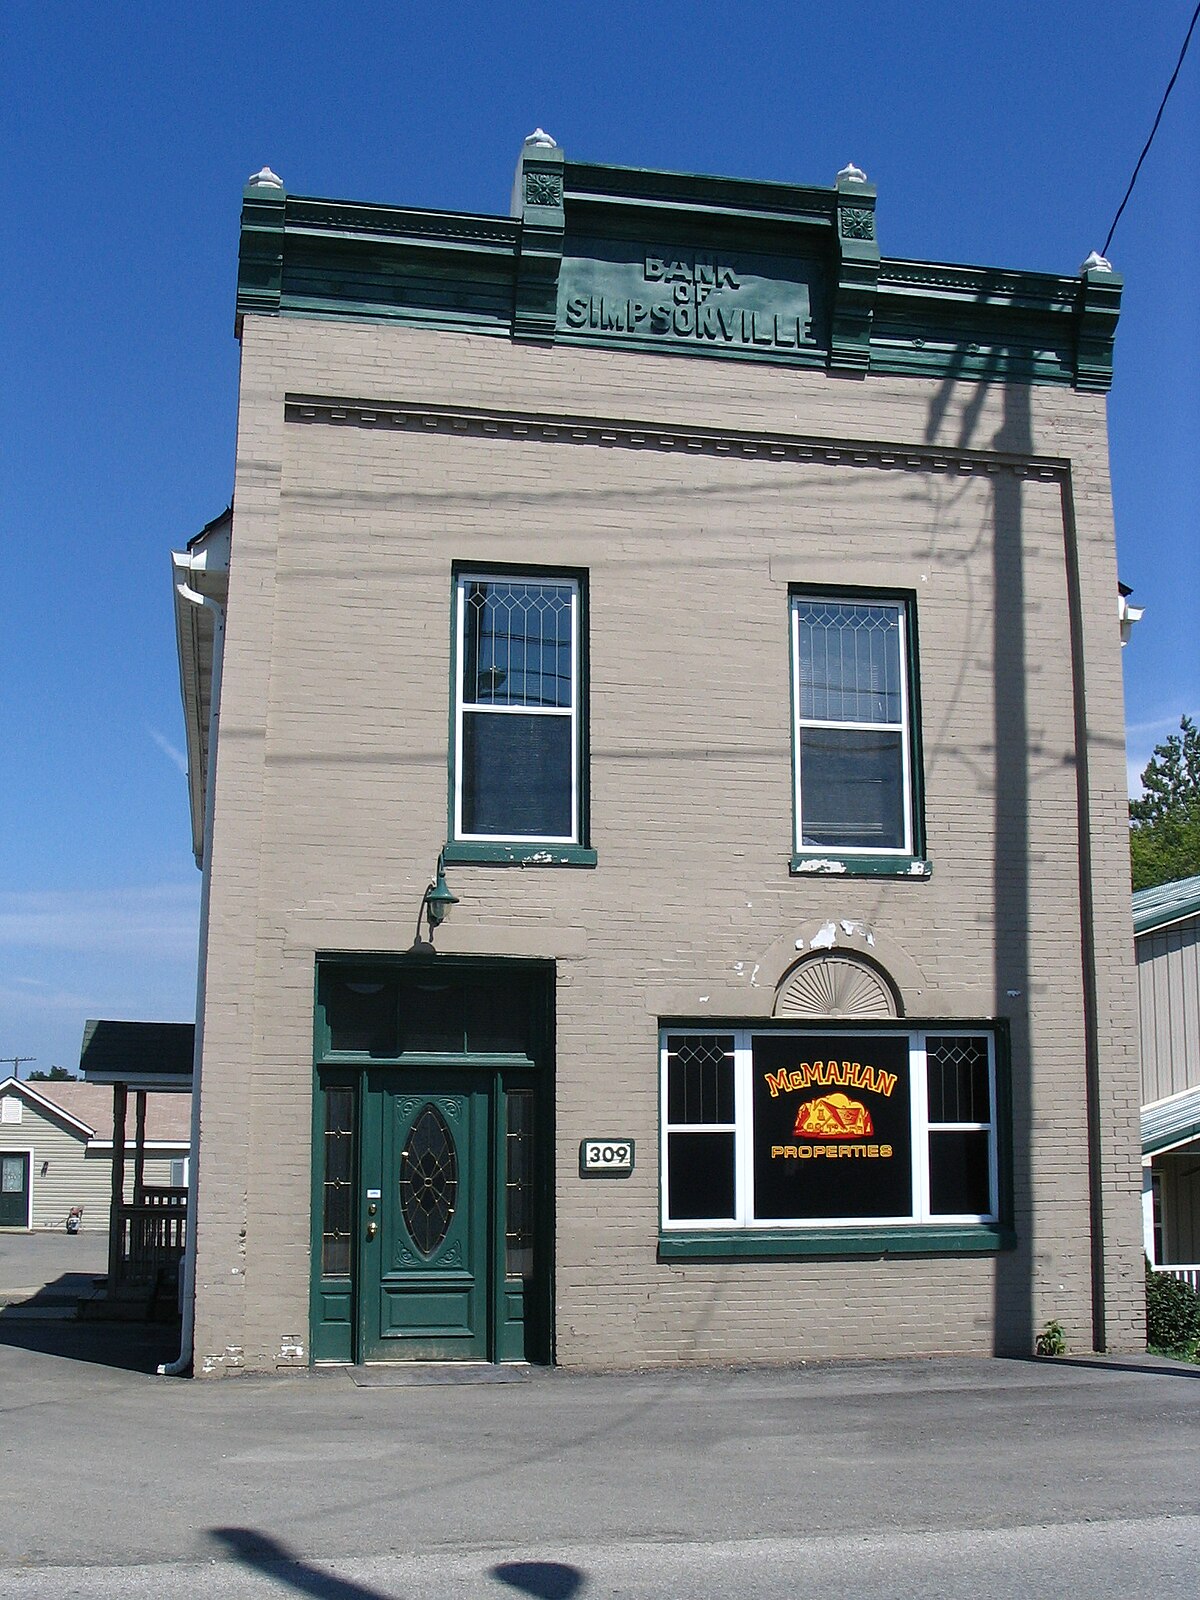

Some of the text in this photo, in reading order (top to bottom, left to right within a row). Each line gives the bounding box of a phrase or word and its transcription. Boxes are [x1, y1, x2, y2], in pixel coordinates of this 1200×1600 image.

[644, 256, 740, 289] BANK
[674, 281, 722, 306] OF
[566, 296, 817, 347] SIMPSONVILLE
[765, 1061, 898, 1097] McMAHAN
[590, 1146, 628, 1163] 309
[771, 1144, 893, 1159] PROPERTIES
